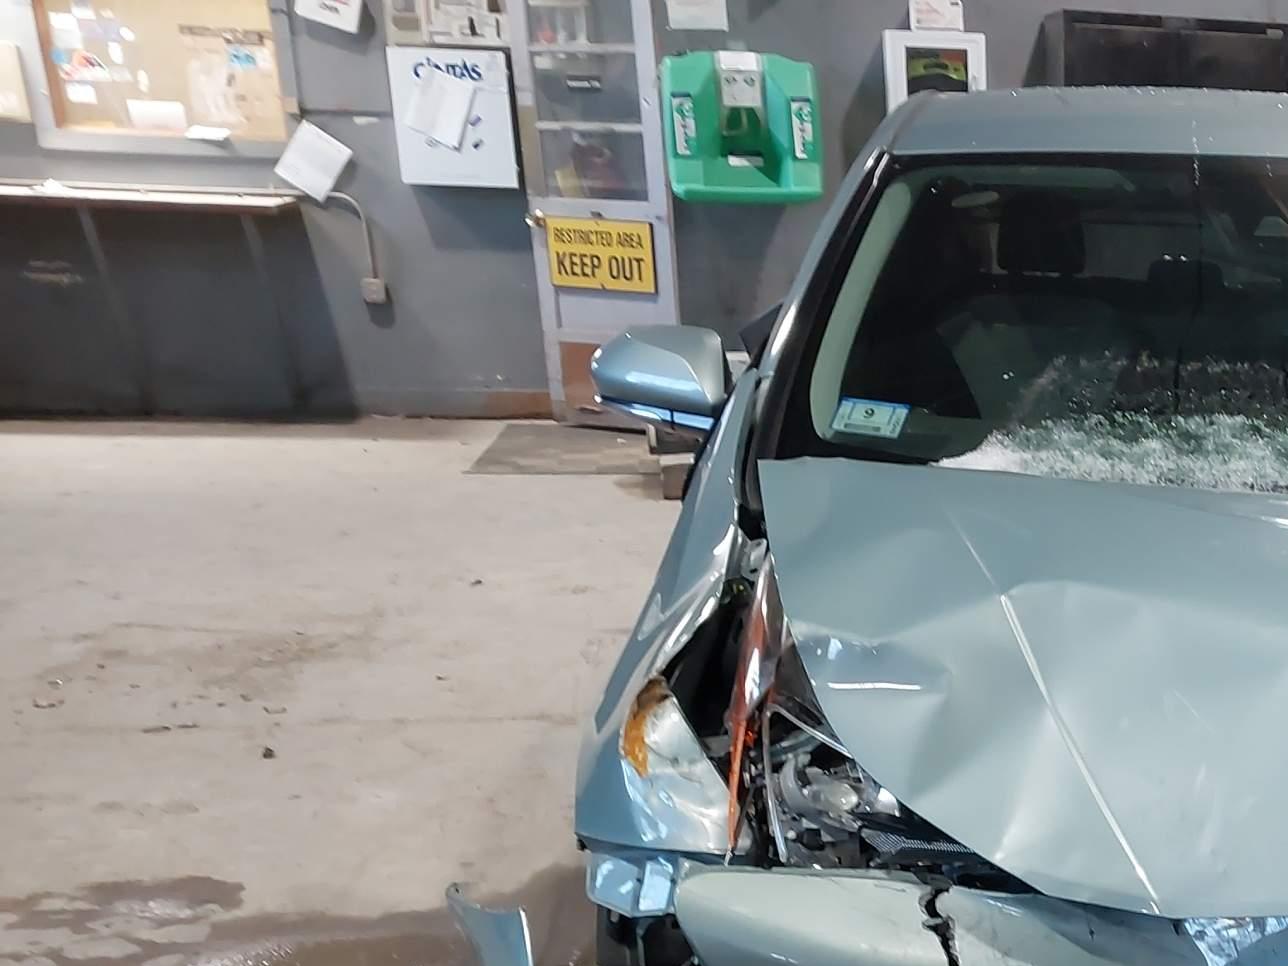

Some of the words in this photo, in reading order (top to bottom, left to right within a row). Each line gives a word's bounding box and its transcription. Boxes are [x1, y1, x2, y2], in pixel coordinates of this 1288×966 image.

[553, 227, 613, 247] RESTRICTED
[616, 231, 644, 249] AREA
[556, 251, 602, 278] KEEP
[608, 255, 645, 282] OUT
